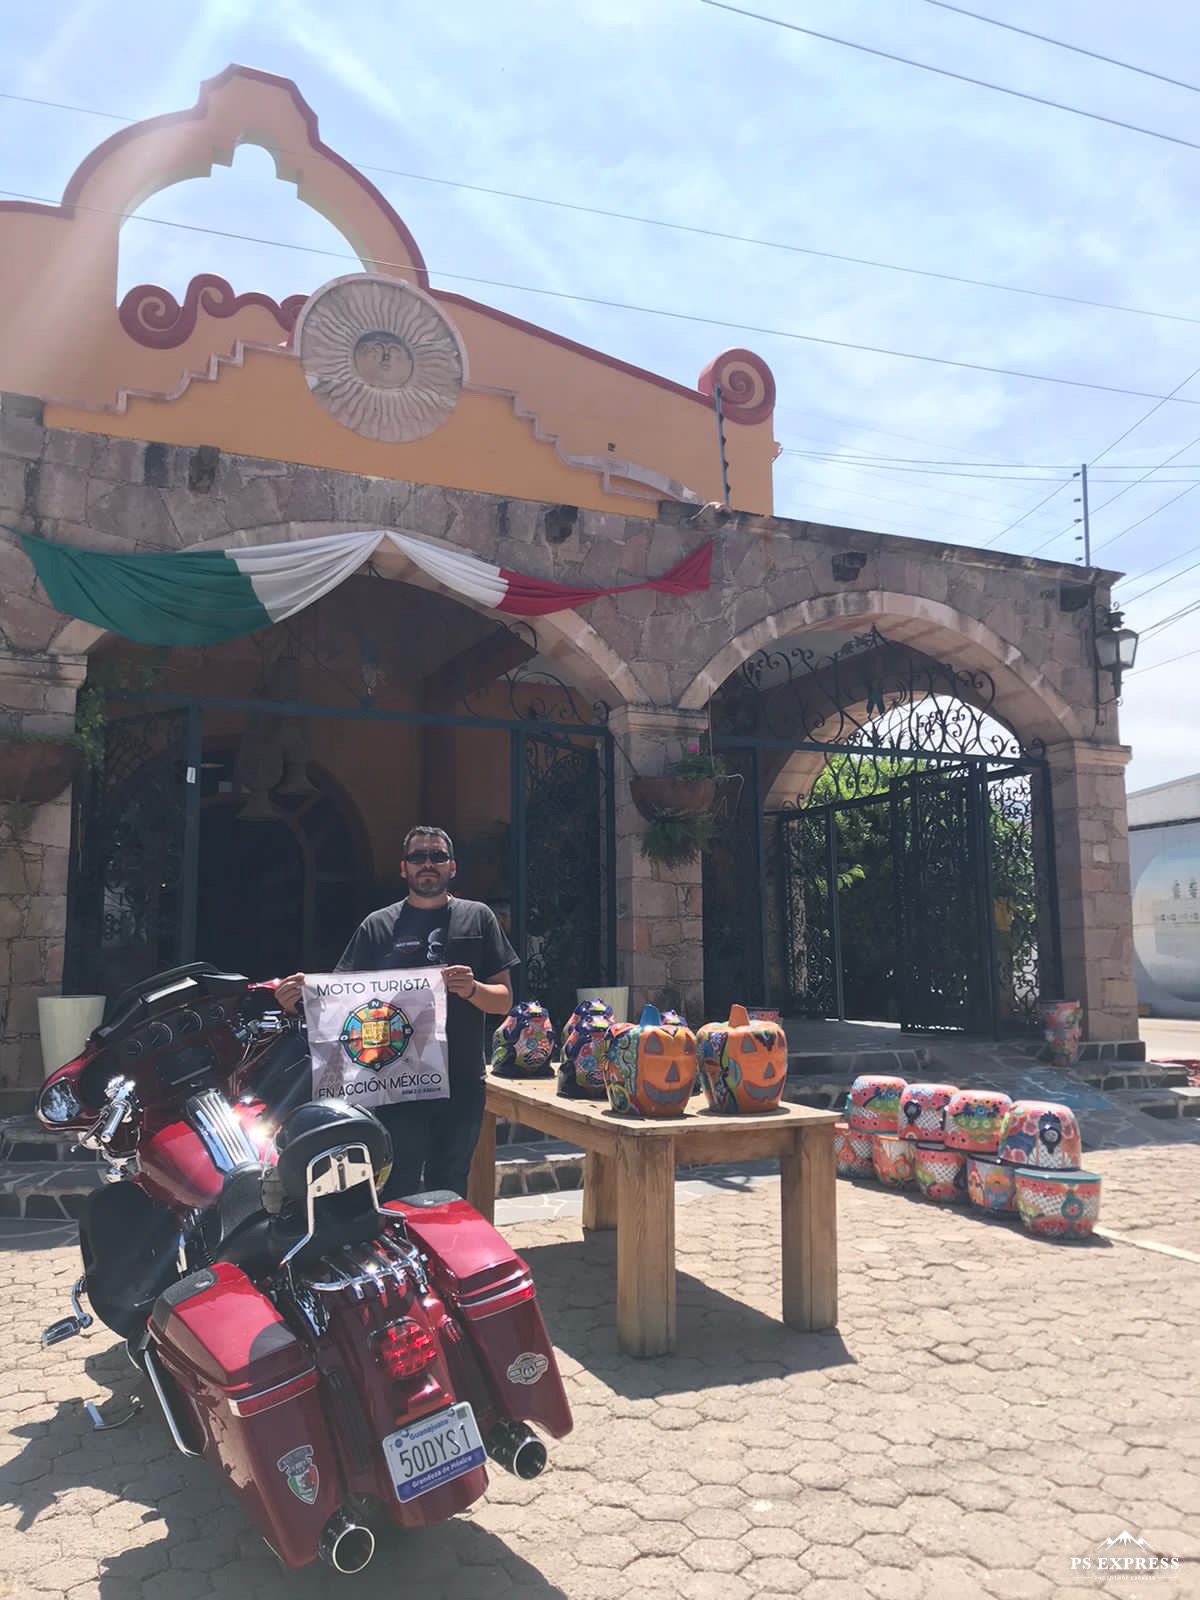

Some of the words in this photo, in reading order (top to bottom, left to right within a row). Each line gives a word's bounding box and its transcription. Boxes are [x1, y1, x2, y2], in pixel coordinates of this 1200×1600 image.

[317, 982, 366, 997] MOTO
[369, 977, 431, 993] TURISTA
[318, 1087, 335, 1098] EN
[337, 1076, 387, 1096] ACCIÓN
[390, 1072, 442, 1088] MÉXICO
[399, 1424, 472, 1478] 50DYS1
